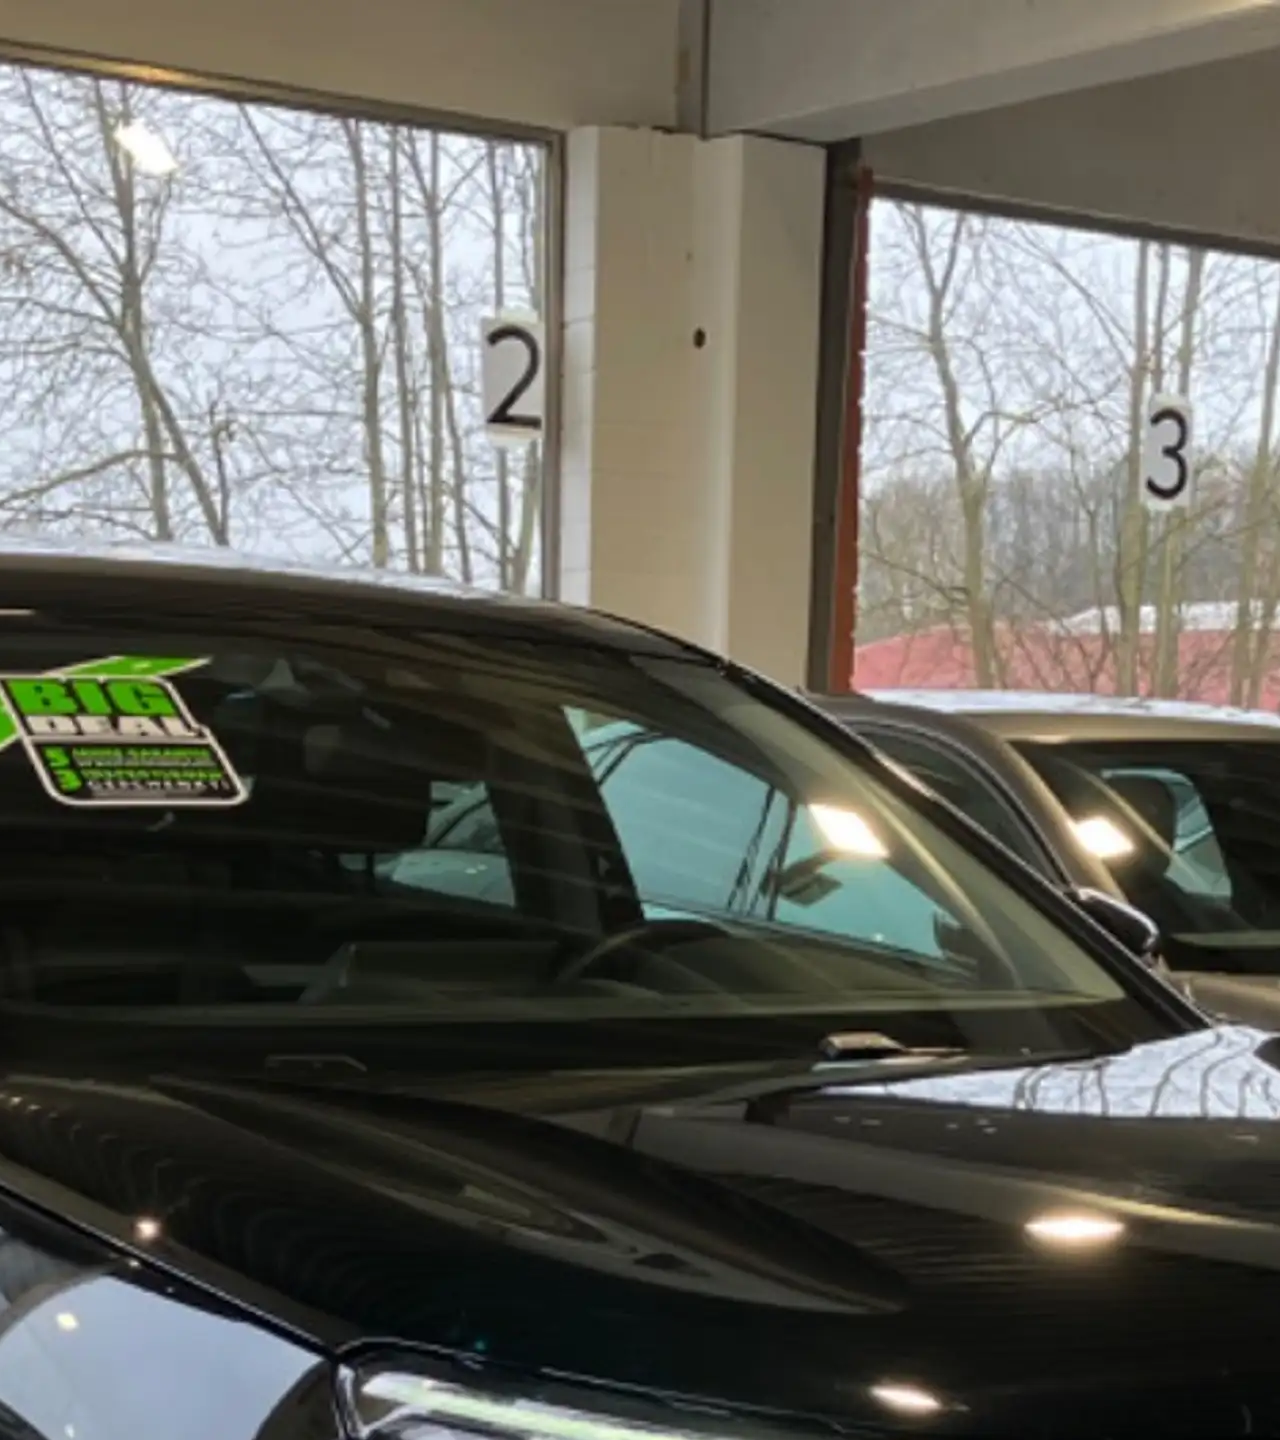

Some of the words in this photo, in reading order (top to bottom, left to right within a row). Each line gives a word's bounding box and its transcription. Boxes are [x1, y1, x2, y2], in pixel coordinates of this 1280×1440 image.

[487, 325, 542, 429] 2
[1146, 408, 1187, 500] 3
[7, 679, 178, 716] BIG
